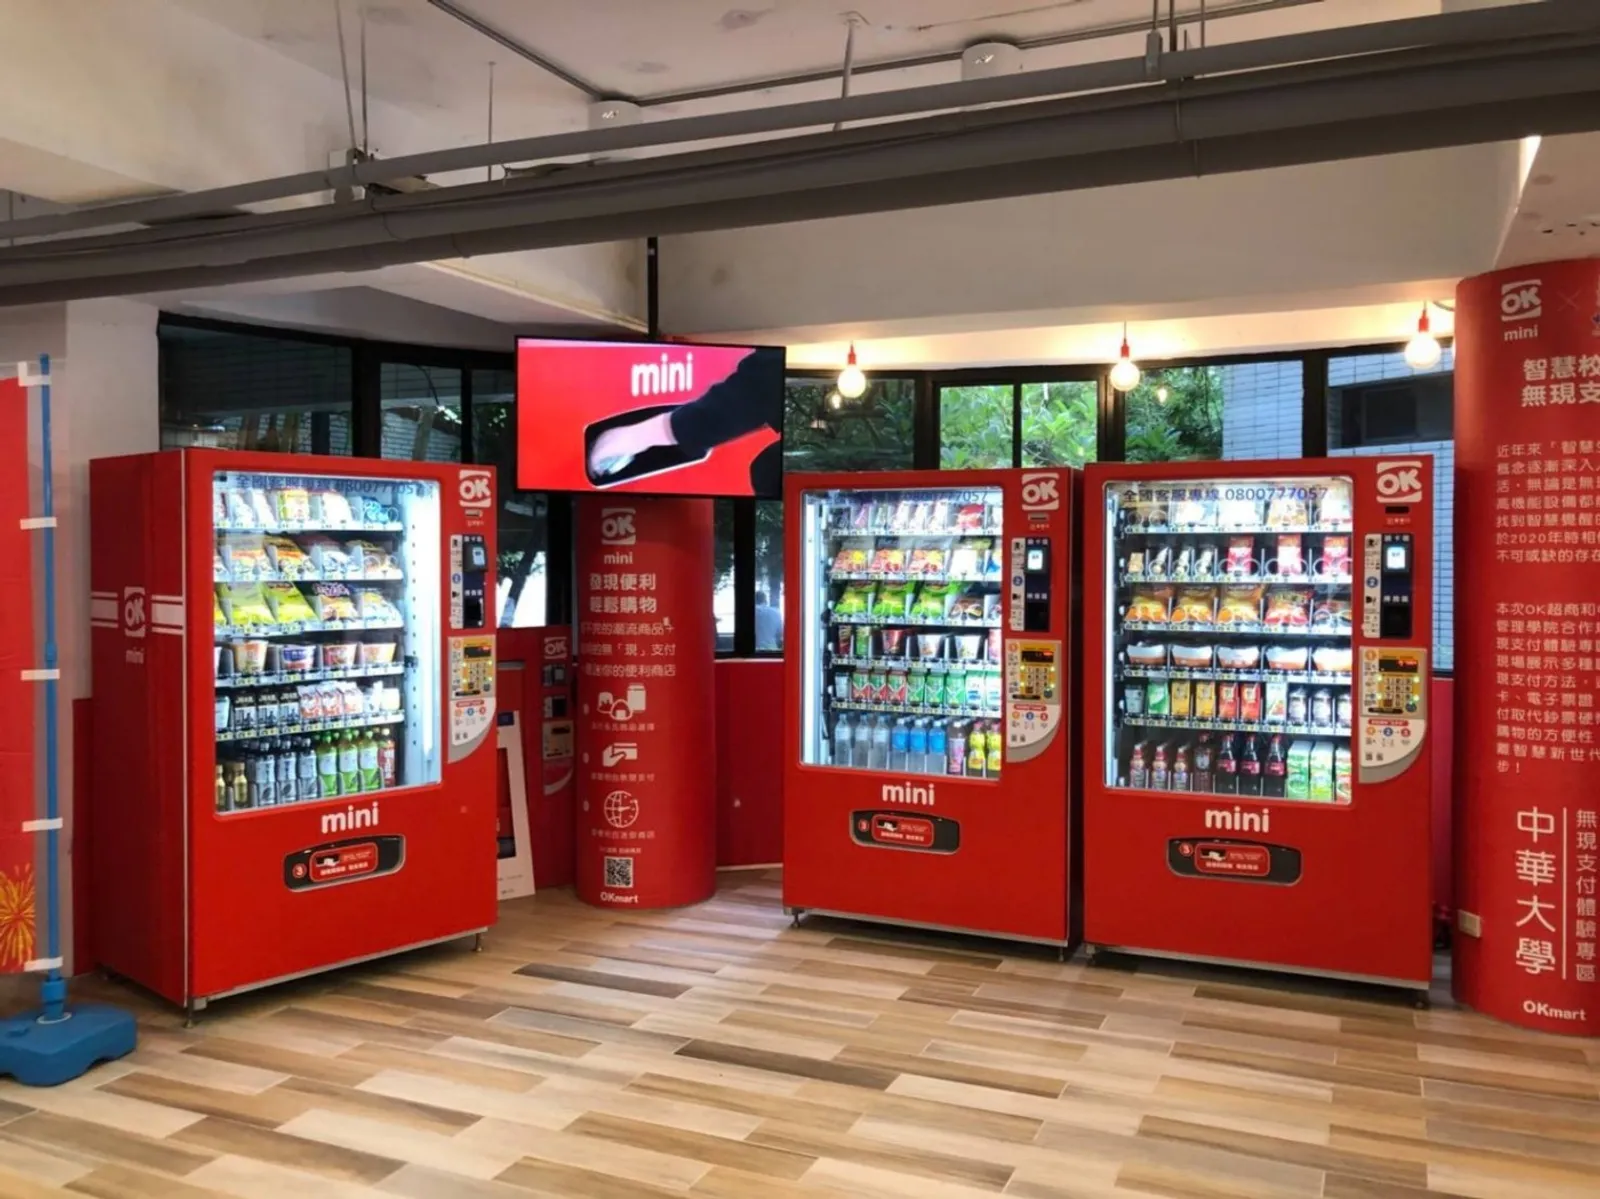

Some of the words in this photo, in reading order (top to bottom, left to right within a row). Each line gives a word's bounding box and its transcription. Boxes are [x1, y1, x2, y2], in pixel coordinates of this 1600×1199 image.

[1501, 285, 1542, 314] OK
[1503, 325, 1539, 341] mini
[631, 351, 693, 397] mini
[1520, 380, 1600, 407] 無現支
[459, 478, 491, 500] OK
[1022, 480, 1060, 503] OK
[1224, 487, 1328, 501] 0800777057
[1376, 468, 1422, 496] OK
[602, 515, 636, 537] OK
[604, 552, 633, 565] mini
[124, 597, 146, 627] OK
[1496, 602, 1600, 617] 本次OK超商和
[544, 636, 567, 656] OK
[881, 781, 936, 806] mini
[320, 801, 379, 835] mini
[1204, 805, 1270, 834] mini
[1515, 805, 1556, 975] 中華大學
[1575, 809, 1598, 983] 無現支付體驗專區
[1522, 1000, 1587, 1021] OKmart
